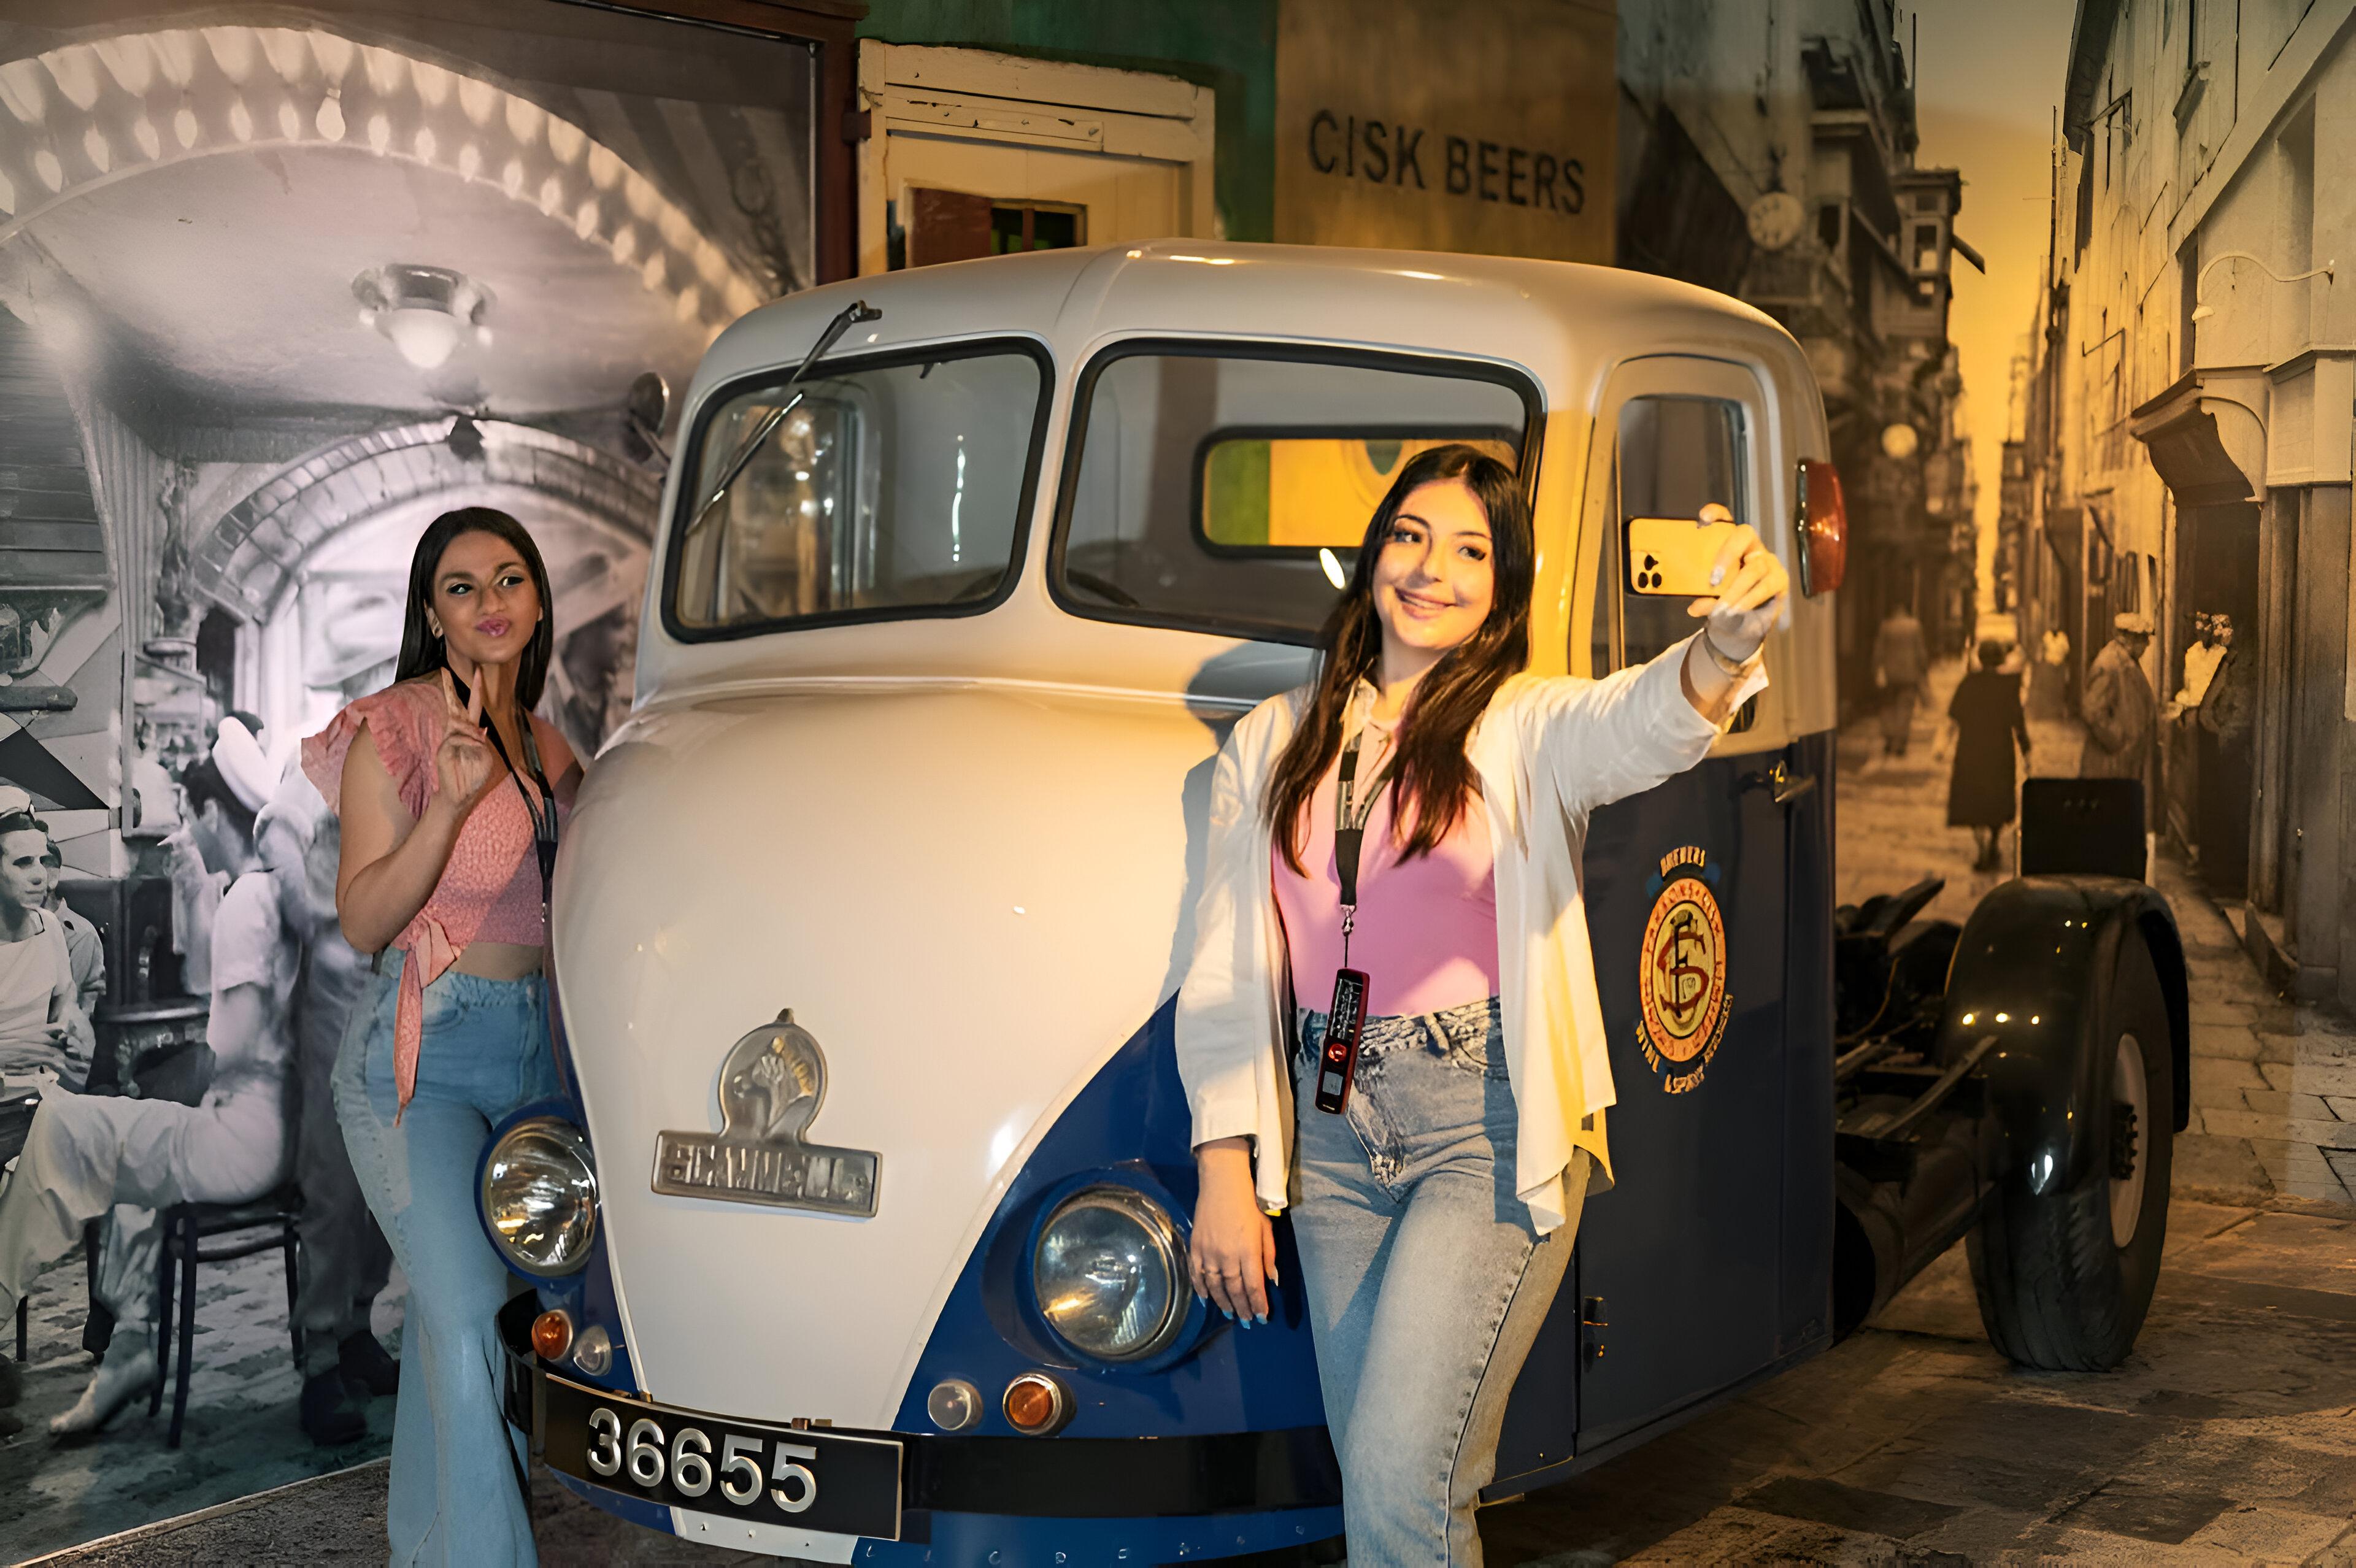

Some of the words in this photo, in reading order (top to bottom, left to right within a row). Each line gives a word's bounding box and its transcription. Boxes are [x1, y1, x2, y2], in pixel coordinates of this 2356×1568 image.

[1308, 109, 1426, 190] CISK
[1444, 134, 1584, 215] BEERS
[586, 1407, 817, 1513] 36655
